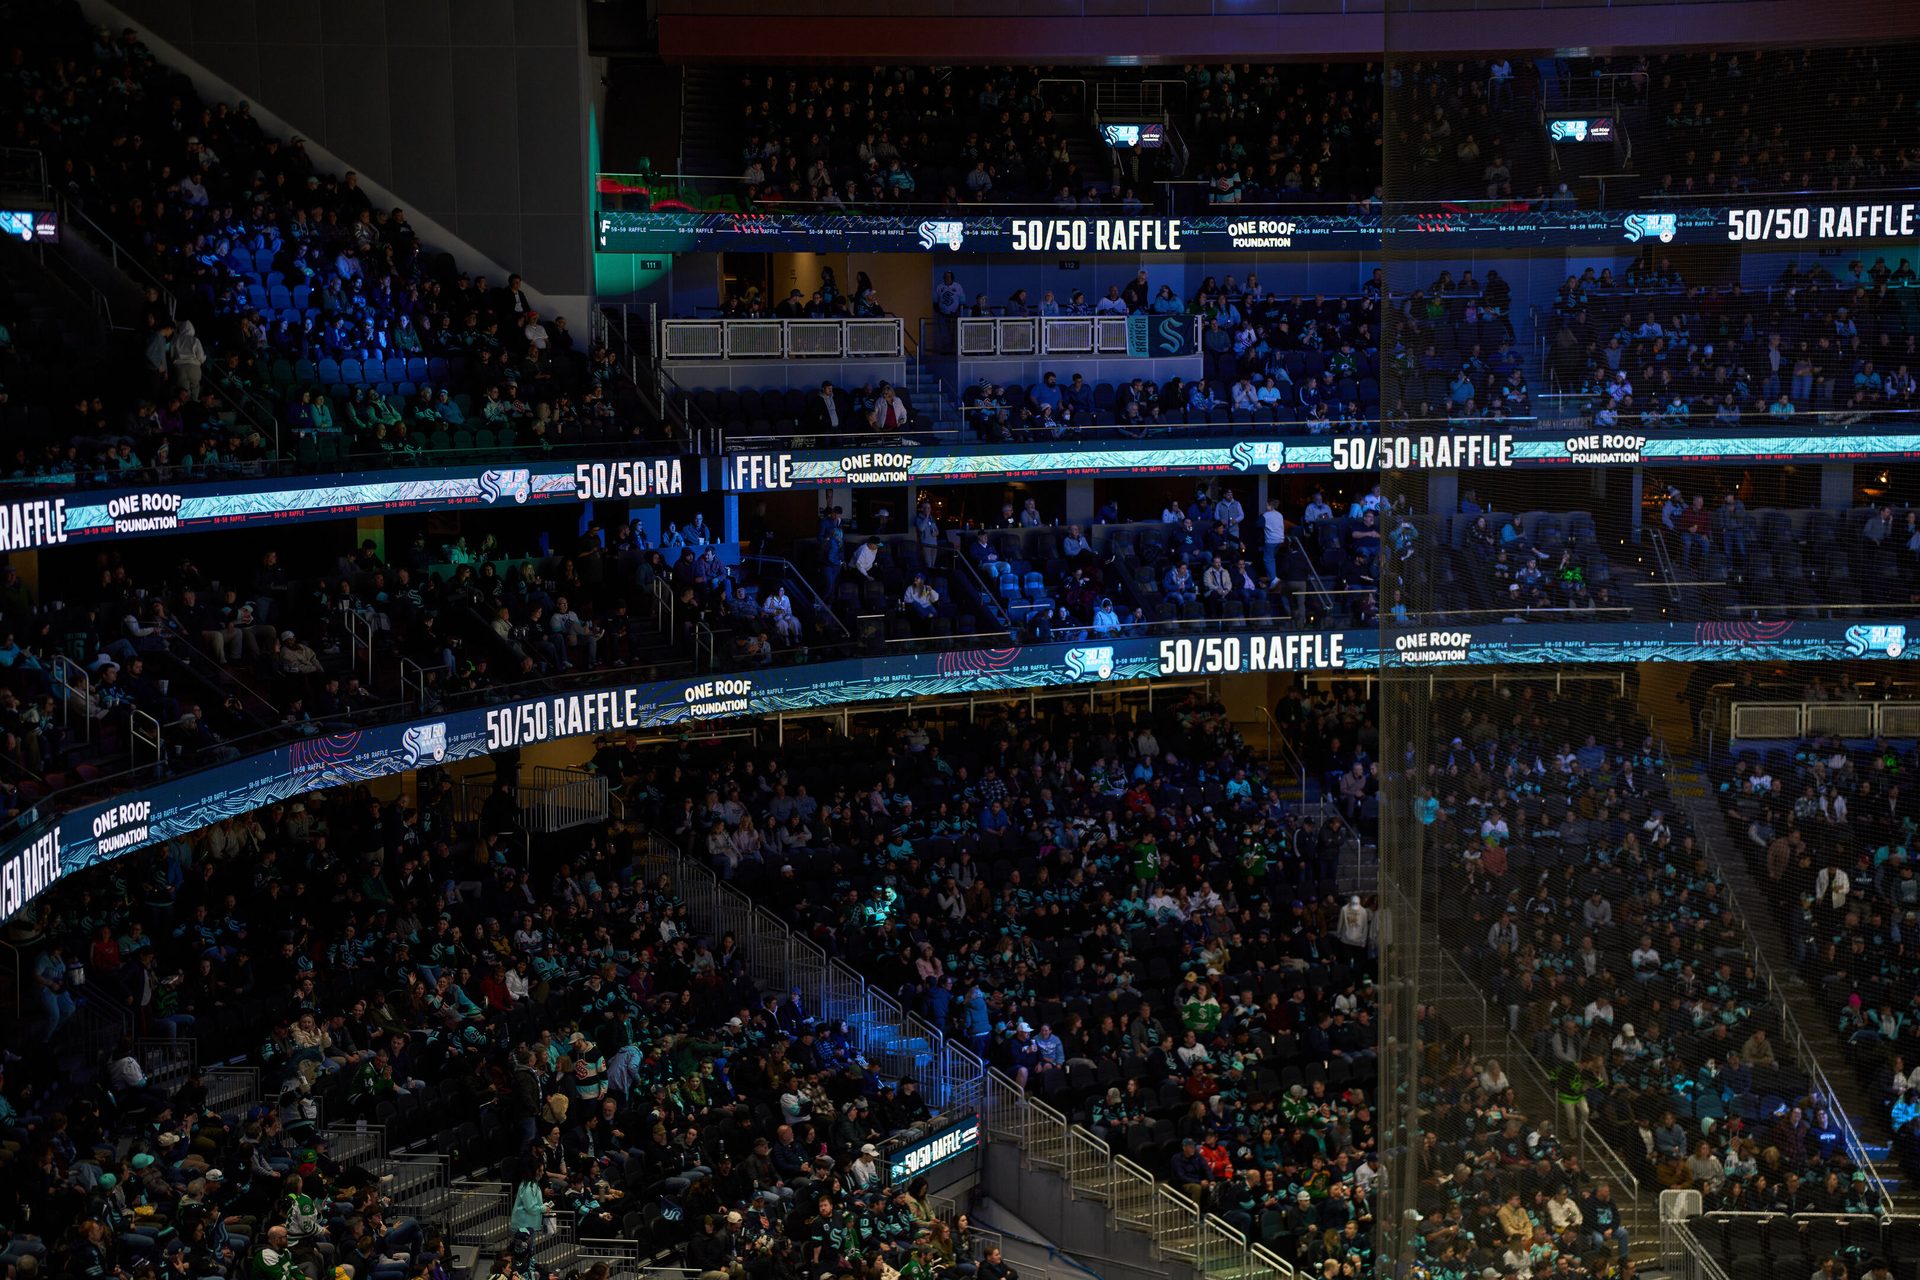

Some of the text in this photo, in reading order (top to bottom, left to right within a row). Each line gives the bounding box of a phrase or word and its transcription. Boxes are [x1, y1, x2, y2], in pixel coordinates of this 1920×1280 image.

[1228, 220, 1296, 236] ONE ROOF
[1728, 204, 1914, 240] 50/50 RAFFLE
[1012, 220, 1181, 250] 50/50 RAFFLE
[1232, 237, 1291, 248] FOUNDATION
[1135, 318, 1146, 352] KRAKEN
[1332, 434, 1513, 470] 50/50 RAFFLE
[1566, 434, 1646, 452] ONE ROOF
[840, 453, 912, 472] ONE ROOF
[1572, 452, 1640, 464] FOUNDATION
[576, 458, 682, 500] 50/50 RA
[730, 454, 792, 490] FFLE
[846, 471, 907, 484] FOUNDATION
[108, 494, 182, 518] ONE ROOF
[0, 498, 67, 551] RAFFLE
[115, 516, 178, 533] FOUNDATION
[1394, 632, 1472, 650] ONE ROOF
[1159, 634, 1344, 674] 50/50 RAFFLE
[1400, 650, 1466, 662] FOUNDATION
[826, 680, 844, 688] RAFFLE
[890, 674, 910, 682] RAFFLE
[684, 680, 752, 703] ONE ROOF
[764, 687, 784, 695] RAFFLE
[690, 698, 747, 716] FOUNDATION
[486, 688, 638, 750] 50/50 RAFFLE
[370, 749, 388, 758] RAFFLE
[261, 776, 273, 786] RAFFLE
[214, 790, 228, 801] RAFFLE
[92, 801, 150, 837] ONE ROOF
[164, 806, 178, 817] RAFFLE
[98, 826, 148, 856] FOUNDATION
[23, 826, 62, 902] RAFFLE
[904, 1144, 931, 1174] 50/50
[932, 1129, 961, 1162] RAFFLE
